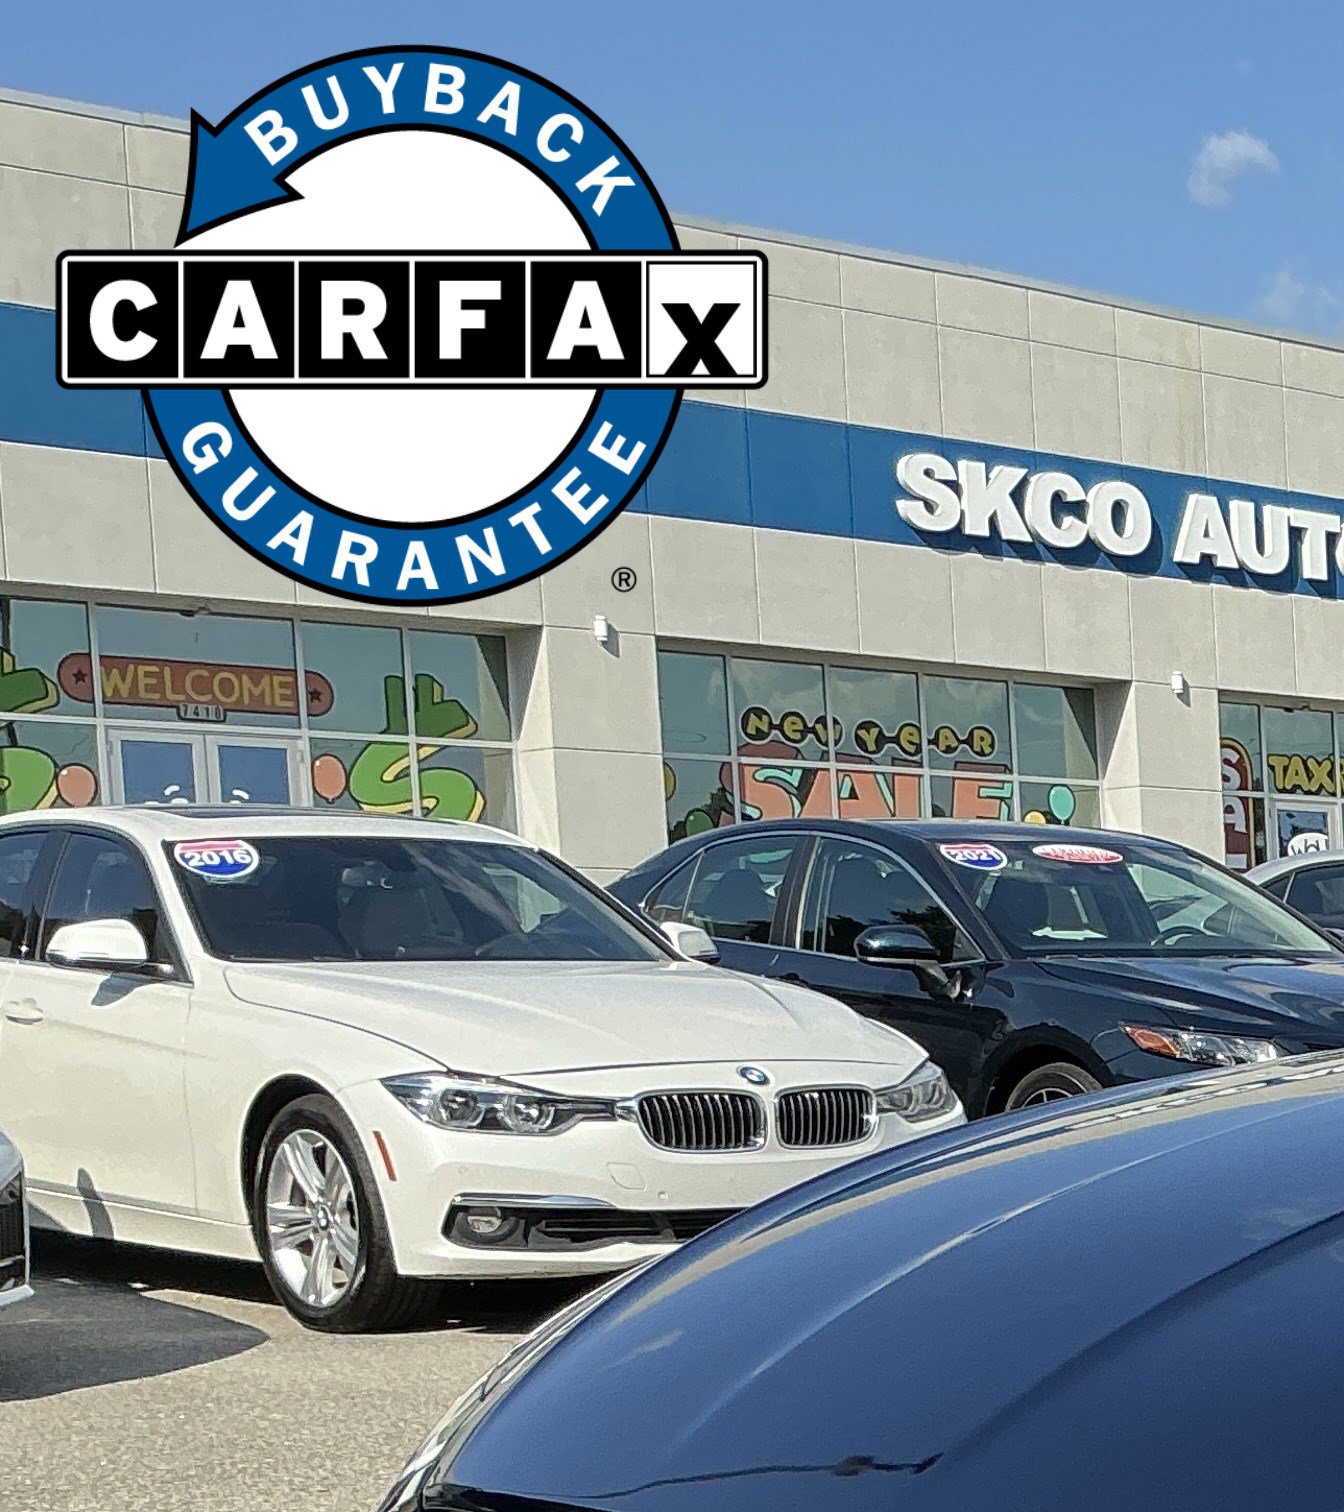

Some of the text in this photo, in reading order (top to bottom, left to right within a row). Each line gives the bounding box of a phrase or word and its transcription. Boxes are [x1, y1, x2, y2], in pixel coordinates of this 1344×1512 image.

[894, 451, 1153, 557] SKCO
[101, 664, 296, 708] WELCOME
[1267, 753, 1336, 796] TAX
[184, 849, 252, 867] 2016
